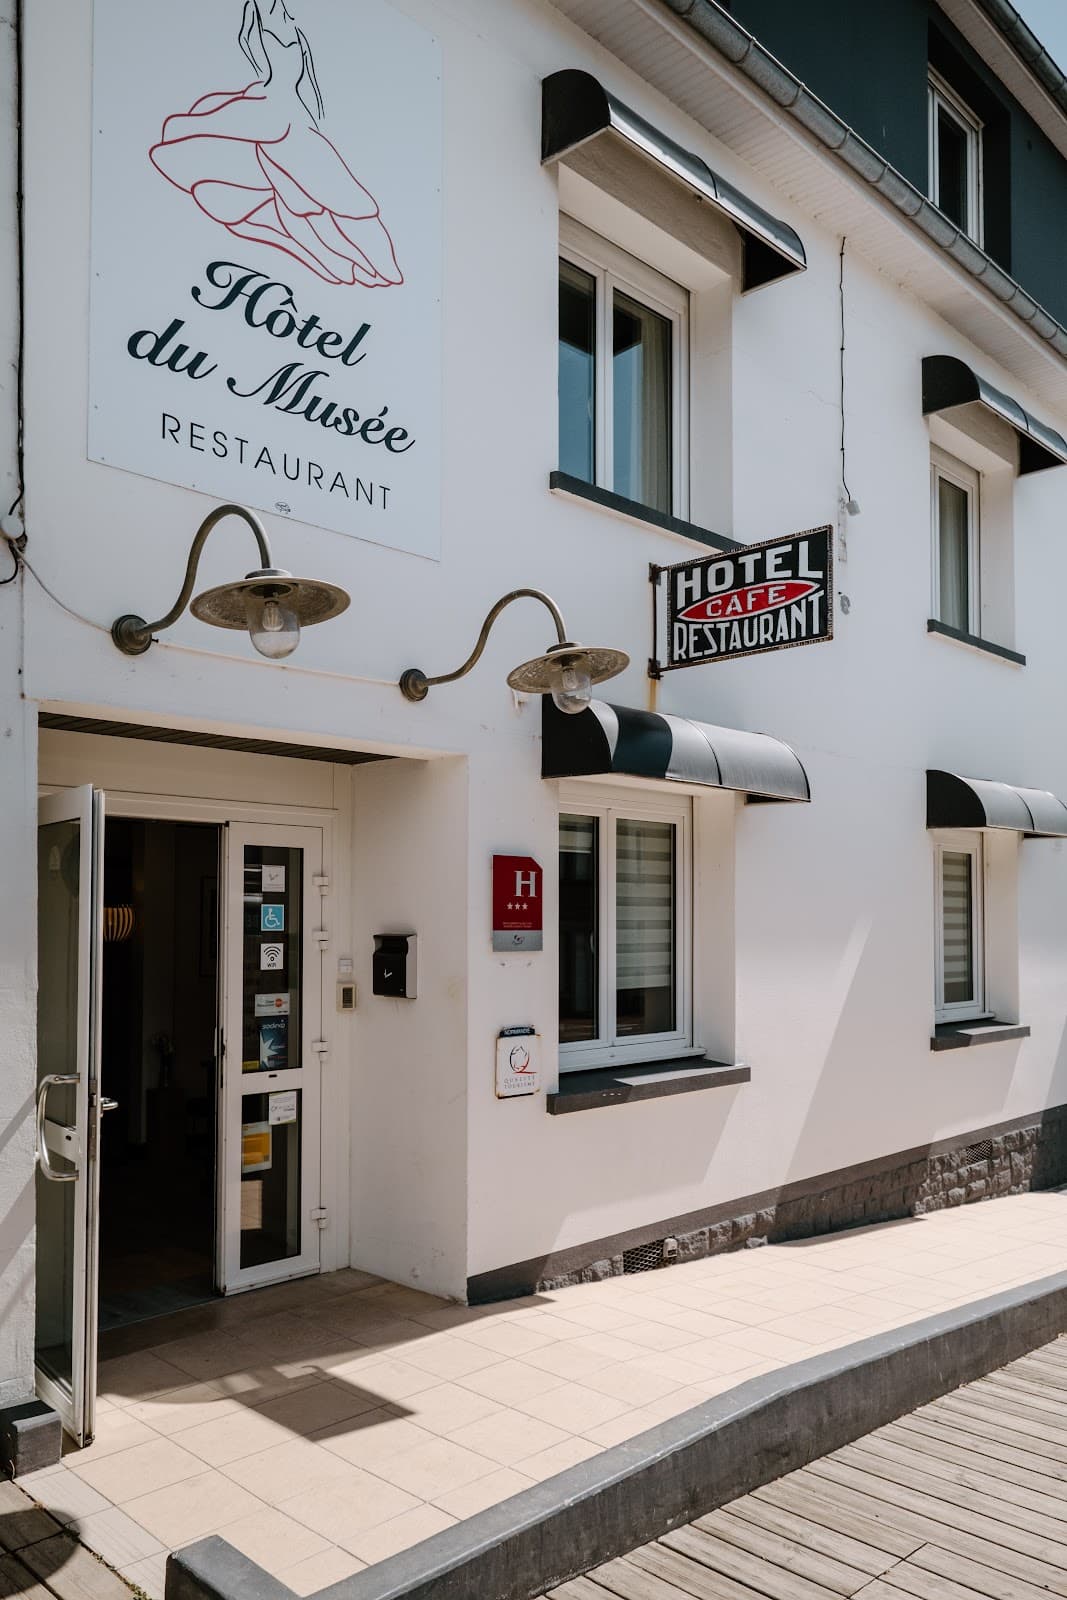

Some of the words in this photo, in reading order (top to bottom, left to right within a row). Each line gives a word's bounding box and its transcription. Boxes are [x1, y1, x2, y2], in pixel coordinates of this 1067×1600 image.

[191, 261, 371, 366] Hôtel
[127, 318, 218, 379] du
[226, 363, 415, 453] Musée
[162, 413, 391, 510] RESTAURANT
[677, 540, 823, 610] HOTEL
[706, 585, 786, 617] CAFE
[673, 590, 825, 660] RESTAURANT
[513, 870, 537, 897] H
